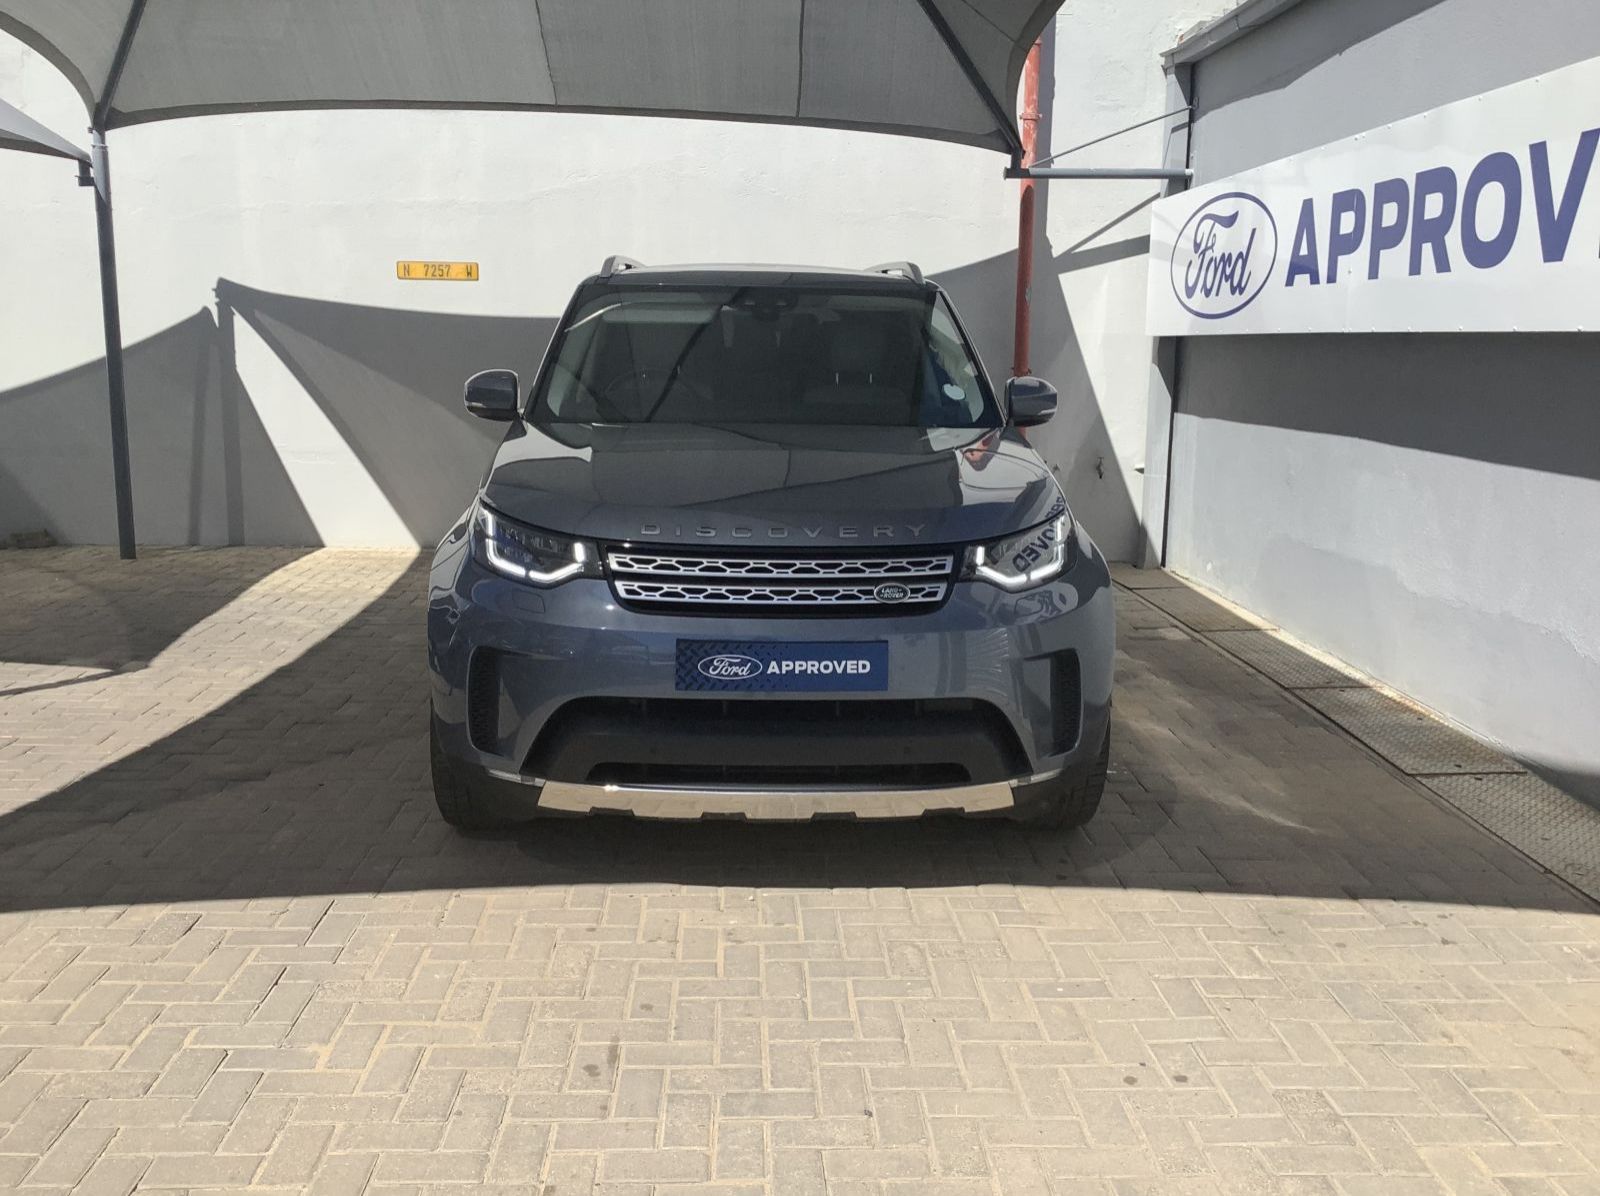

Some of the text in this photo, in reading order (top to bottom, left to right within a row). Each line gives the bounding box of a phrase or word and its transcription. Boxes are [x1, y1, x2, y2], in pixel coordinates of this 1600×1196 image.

[1184, 127, 1600, 299] Ford APPROV
[403, 263, 410, 277] N
[423, 264, 451, 278] 7257
[640, 522, 926, 538] DISCOVERY
[708, 656, 871, 677] Ford APPROVED
